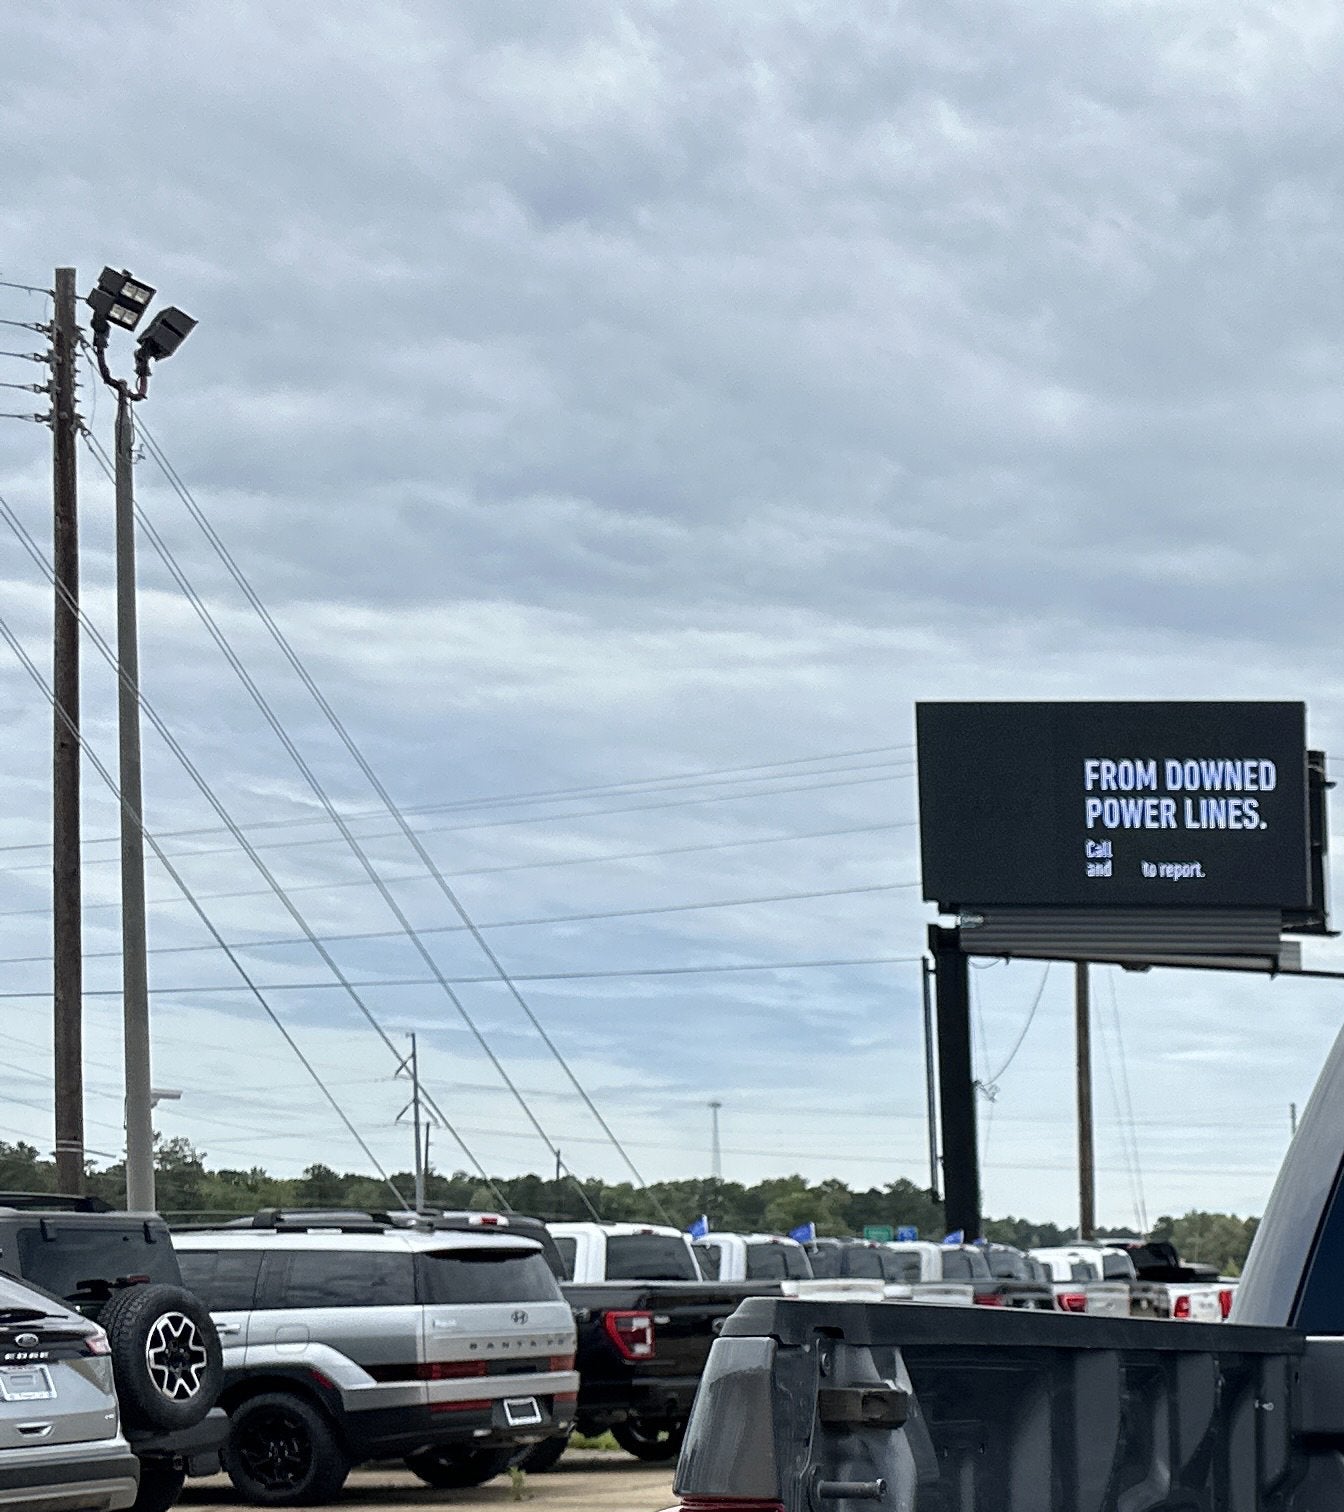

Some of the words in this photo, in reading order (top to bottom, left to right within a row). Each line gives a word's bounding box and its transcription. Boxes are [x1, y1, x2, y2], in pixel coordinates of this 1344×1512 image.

[1084, 759, 1157, 790] FROM
[1165, 759, 1276, 791] DOWNED
[1085, 796, 1177, 828] POWER
[1184, 796, 1268, 829] LINES.
[1086, 839, 1113, 858] Call
[1086, 860, 1112, 877] and
[1141, 860, 1157, 877] to
[1159, 861, 1206, 881] report.
